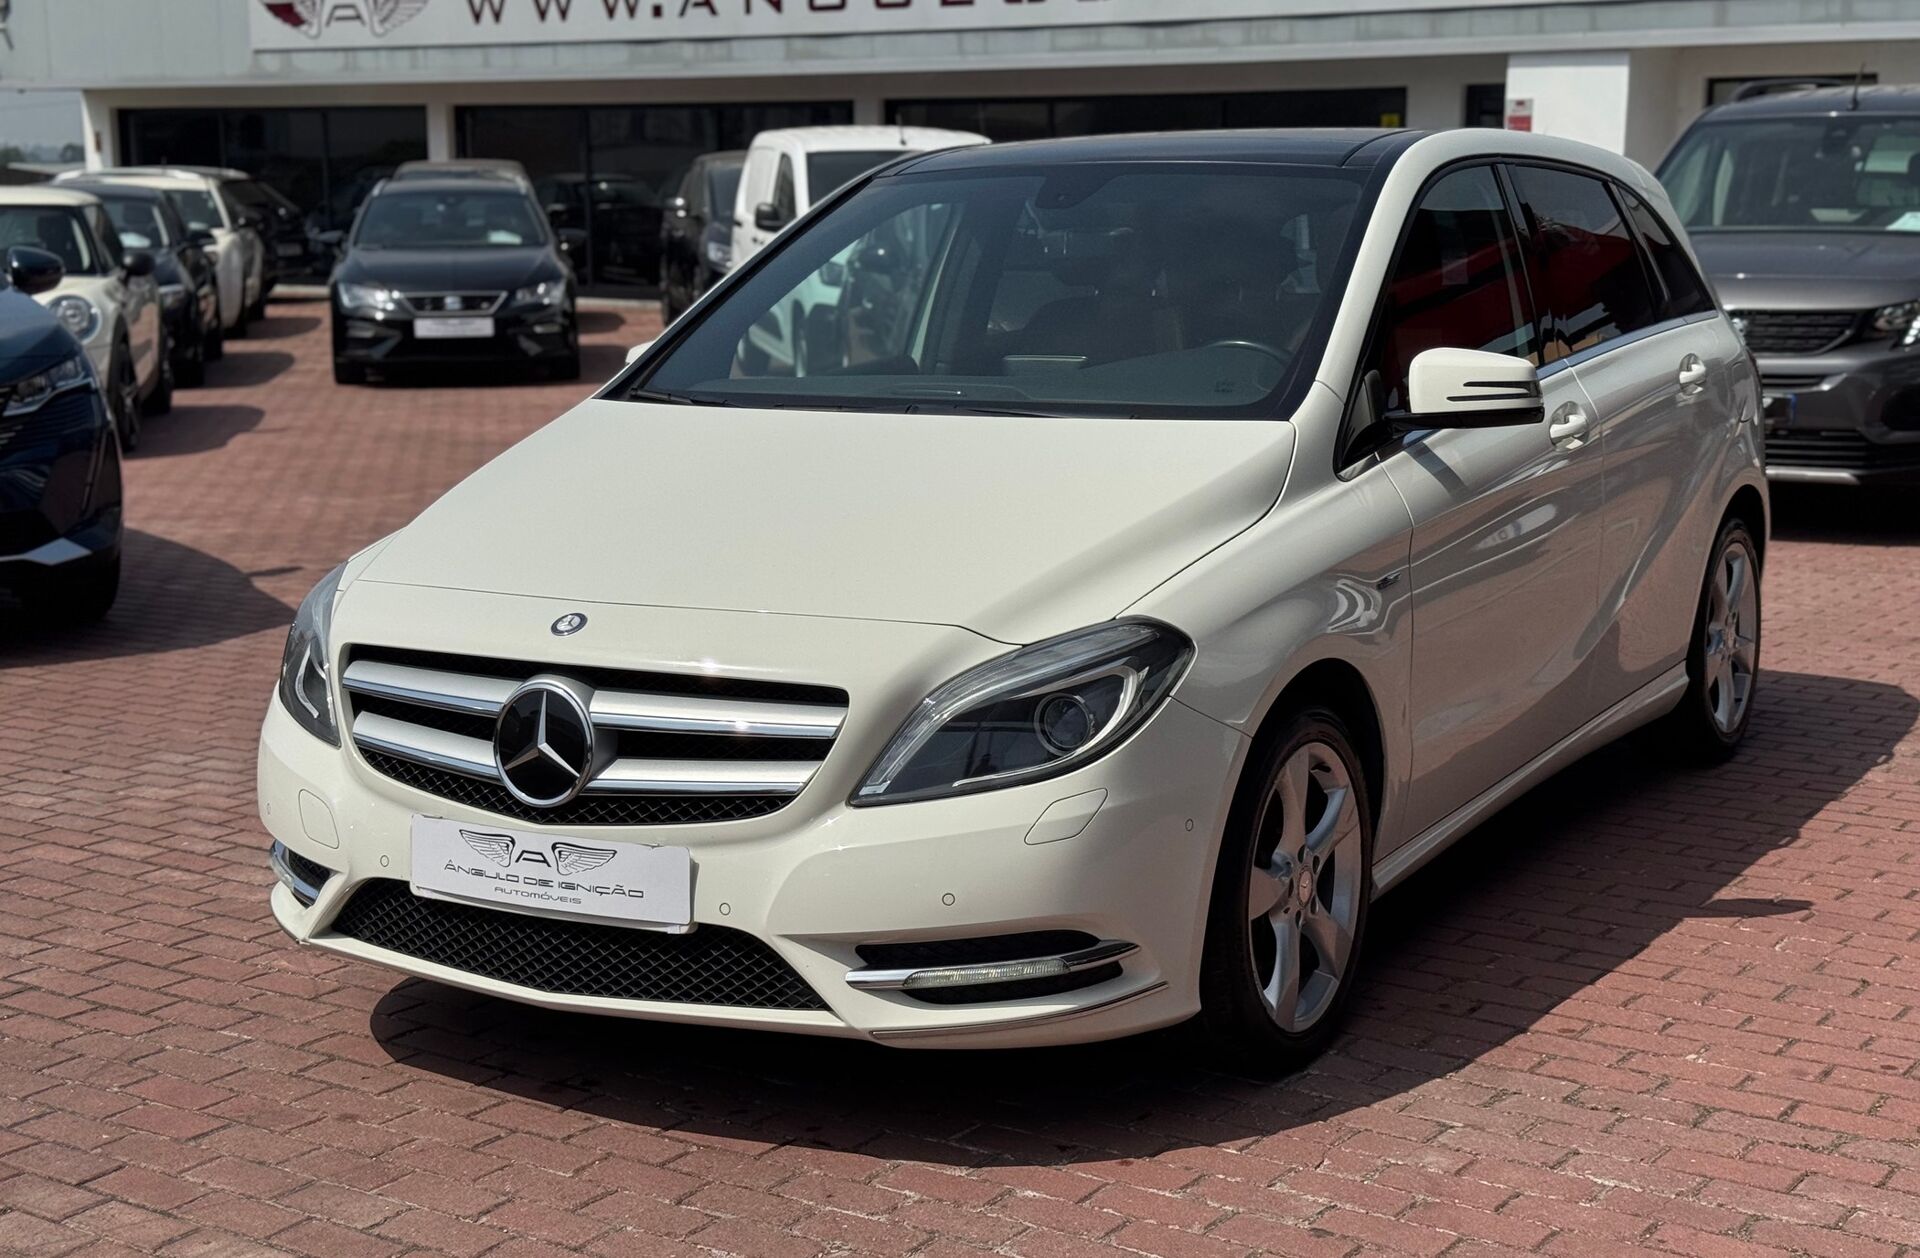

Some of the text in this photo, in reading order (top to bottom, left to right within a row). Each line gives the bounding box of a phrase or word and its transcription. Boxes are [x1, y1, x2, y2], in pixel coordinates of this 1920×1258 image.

[444, 859, 644, 898] ÂNGULO DE IGNIÇÃO
[494, 886, 582, 904] AUTOMÓVEIS
